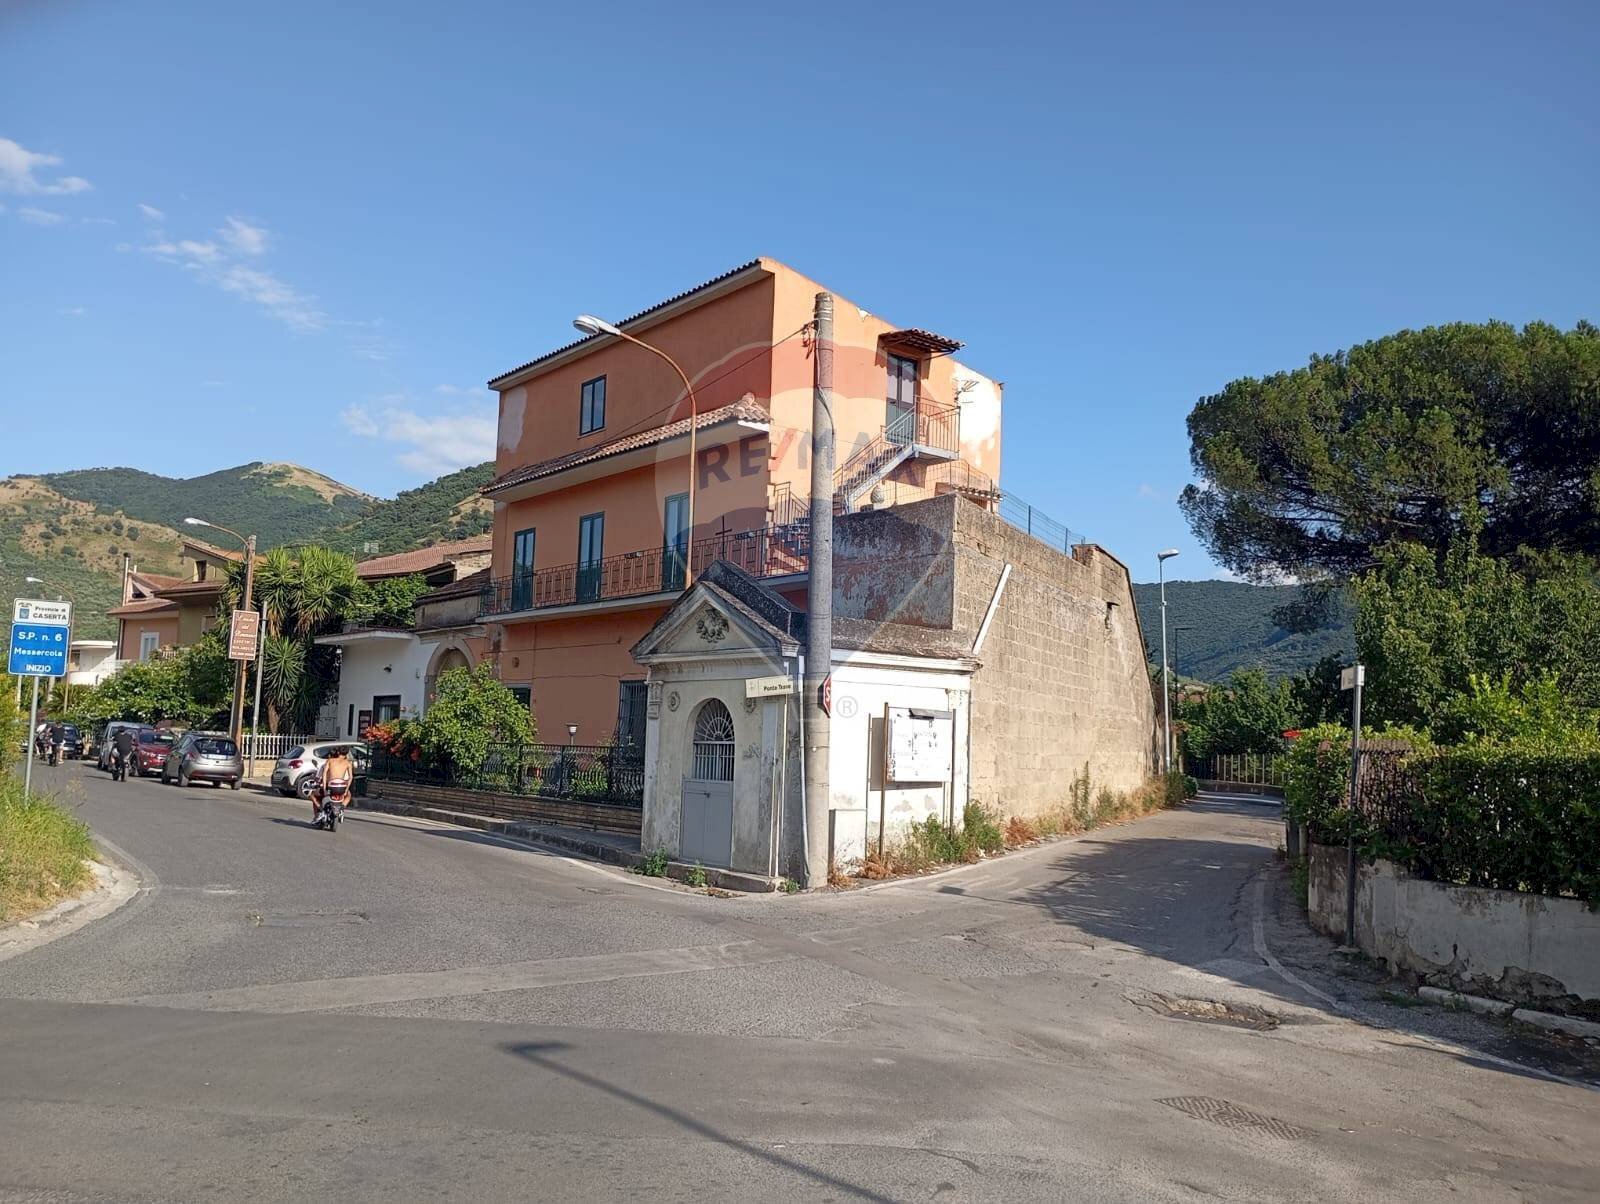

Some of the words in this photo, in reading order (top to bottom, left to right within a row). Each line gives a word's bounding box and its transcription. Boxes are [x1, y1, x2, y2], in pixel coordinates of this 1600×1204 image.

[33, 612, 66, 620] CASERTA
[55, 633, 63, 642] 6
[14, 647, 63, 657] Messercola
[26, 664, 52, 673] INIZIO
